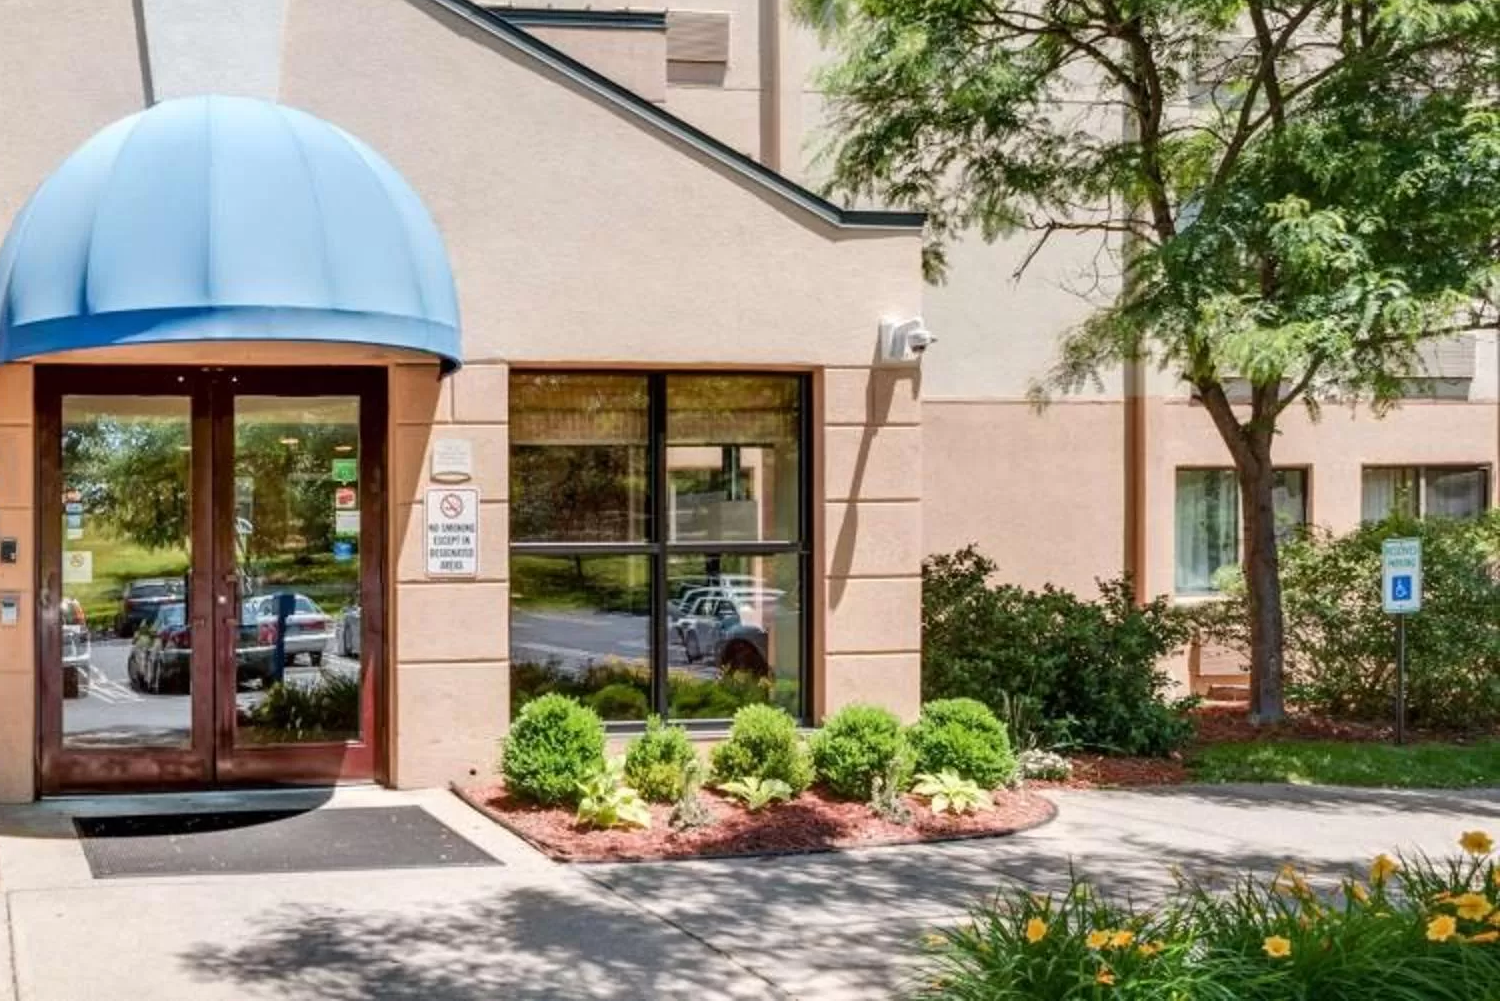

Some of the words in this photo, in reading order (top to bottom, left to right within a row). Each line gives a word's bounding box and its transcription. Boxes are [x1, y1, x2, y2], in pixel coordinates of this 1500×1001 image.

[428, 522, 439, 533] NO
[441, 522, 475, 533] SMOKING
[433, 535, 460, 546] EXCEPT
[462, 535, 470, 545] IN
[429, 548, 474, 558] DESIGNATED
[440, 560, 463, 570] AREAS
